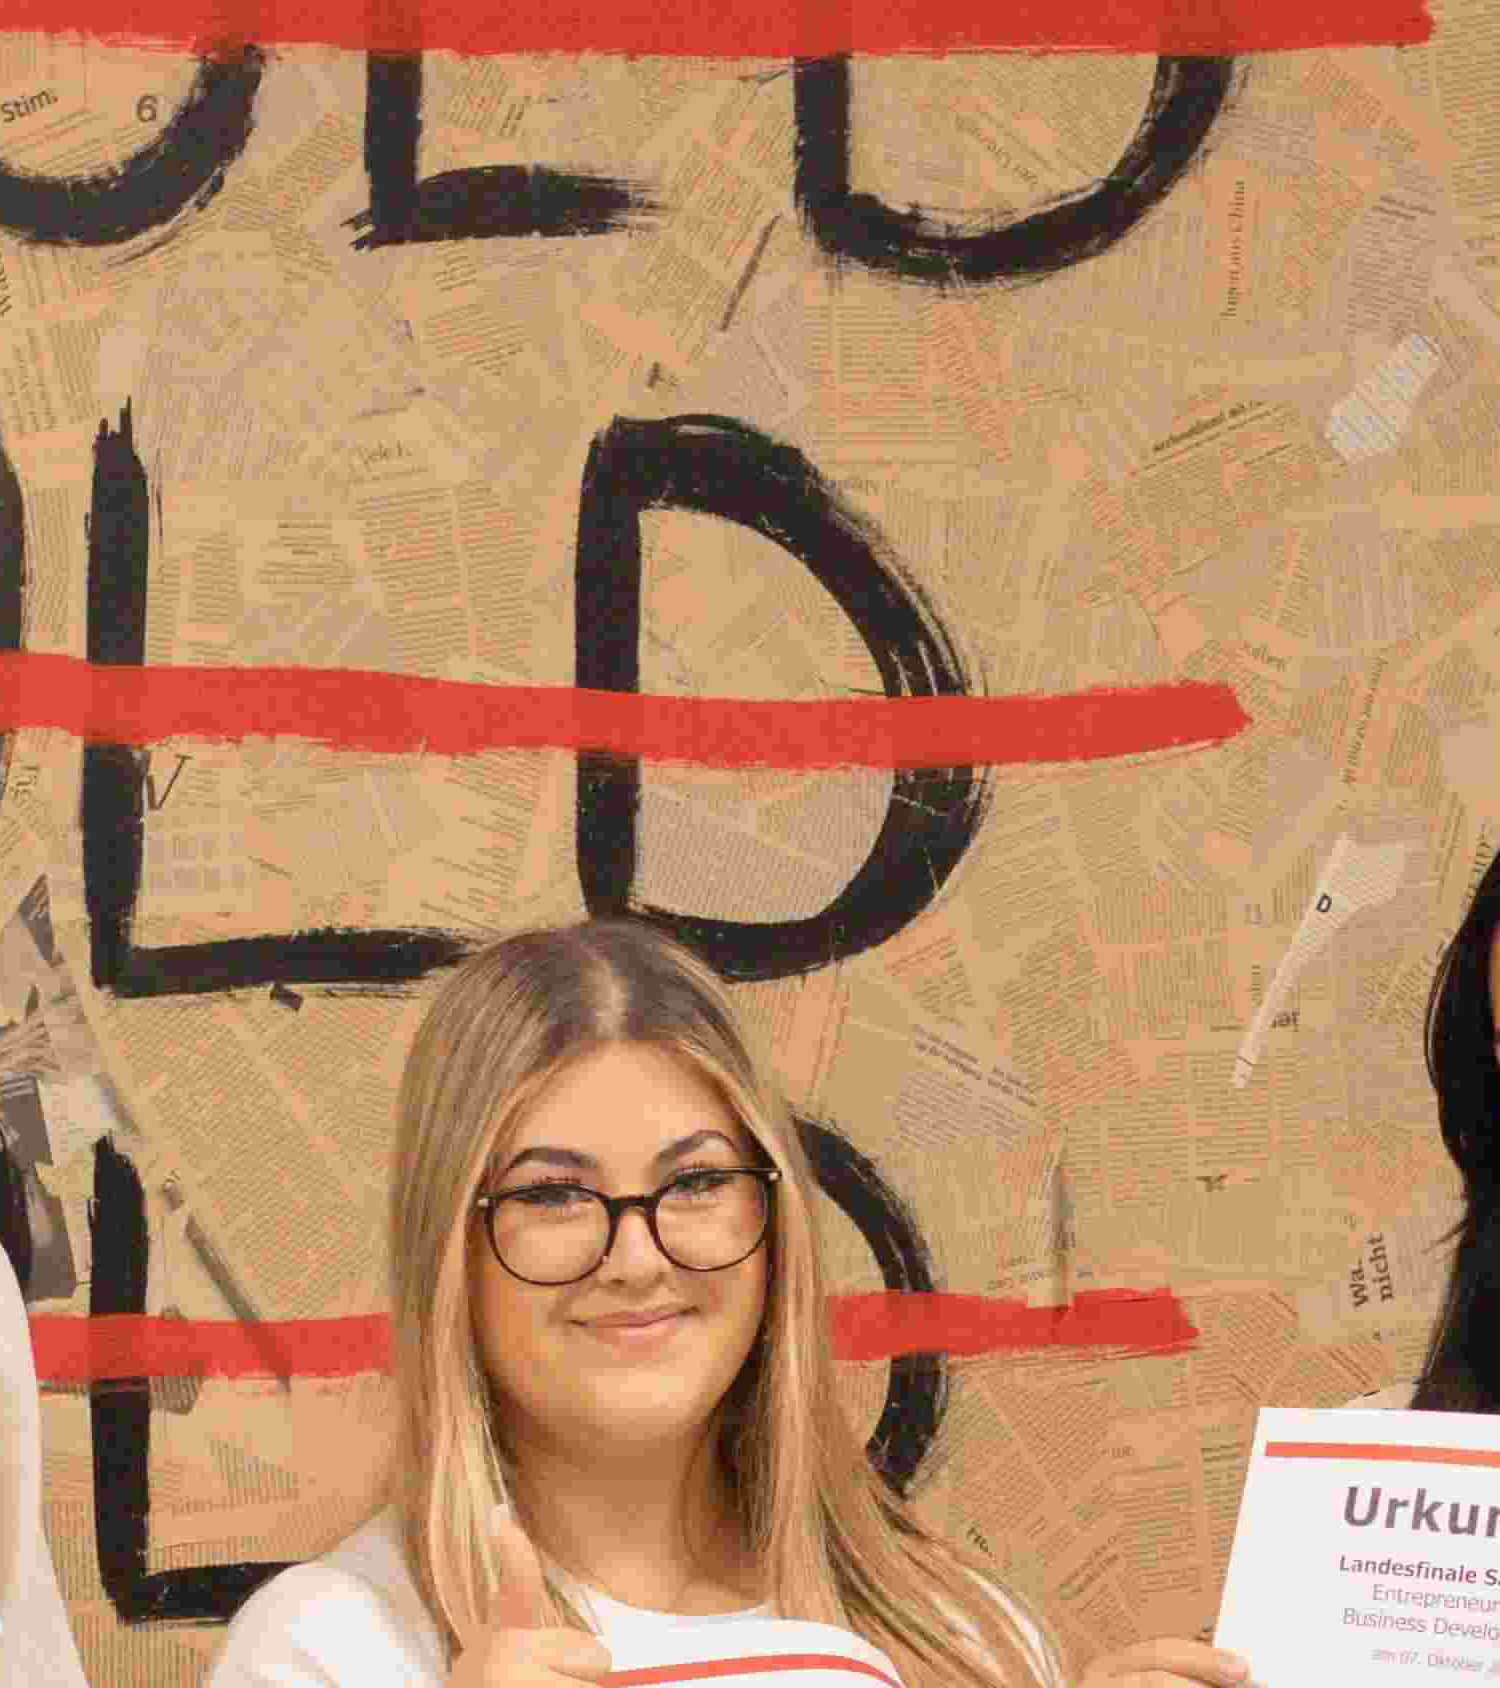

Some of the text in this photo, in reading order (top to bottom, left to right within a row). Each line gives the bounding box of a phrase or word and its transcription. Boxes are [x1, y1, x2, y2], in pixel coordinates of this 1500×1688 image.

[135, 95, 159, 124] 6
[1316, 892, 1332, 913] D
[1367, 1233, 1395, 1303] nicht
[1339, 1555, 1477, 1585] Landesfinale
[1343, 1607, 1428, 1634] Business
